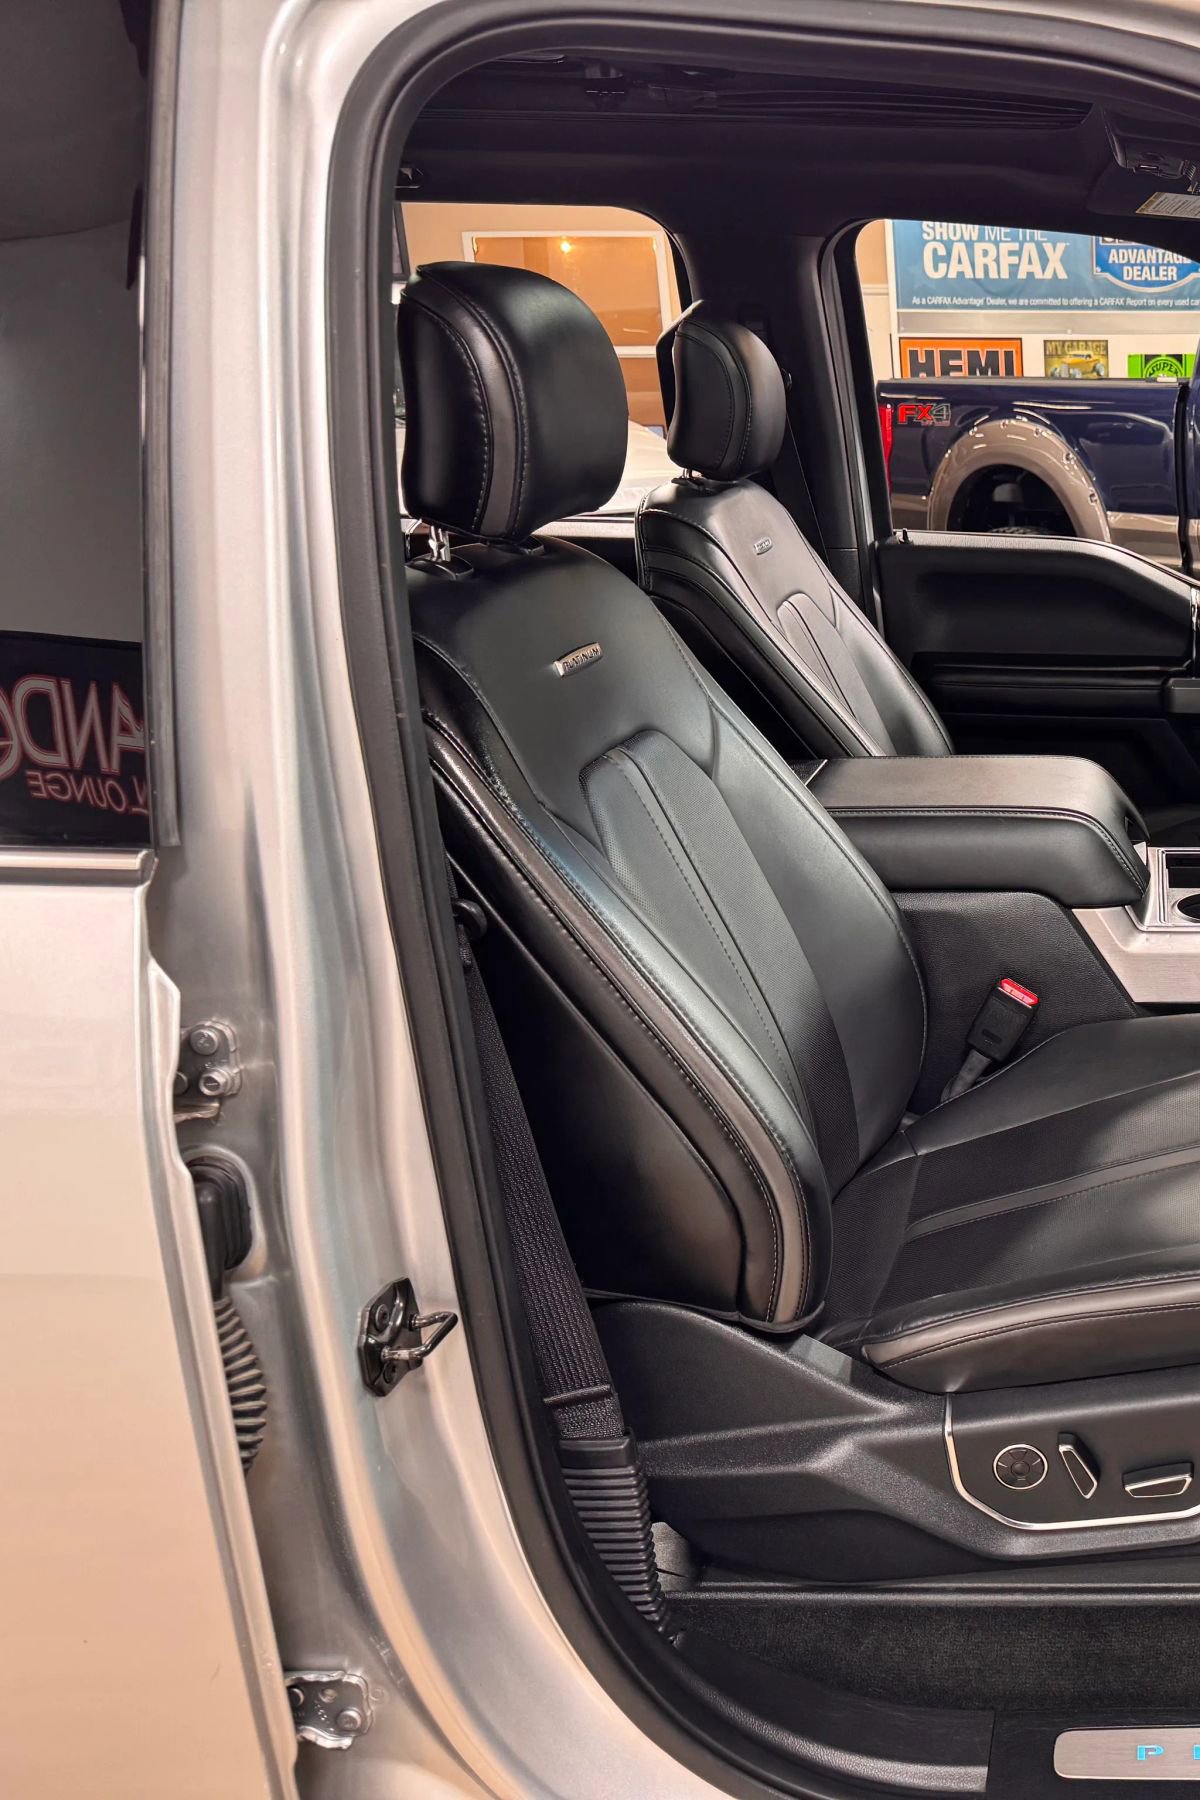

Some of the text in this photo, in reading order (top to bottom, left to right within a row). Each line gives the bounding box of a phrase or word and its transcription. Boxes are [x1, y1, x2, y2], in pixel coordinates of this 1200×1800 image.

[922, 221, 979, 241] SHOW
[984, 226, 1011, 241] ME
[923, 241, 1068, 280] CARFAX
[1123, 265, 1178, 281] DEALER
[927, 296, 952, 306] CARFAX
[1030, 296, 1061, 306] committed
[1068, 297, 1092, 308] offering
[1100, 297, 1124, 306] CARFAX
[1126, 297, 1147, 308] Report
[1157, 298, 1173, 308] every
[1175, 297, 1189, 306] used
[1046, 340, 1107, 355] MY GARAGE
[908, 349, 1014, 377] HEMI
[898, 403, 951, 425] FX4
[562, 646, 601, 672] PLATINUM
